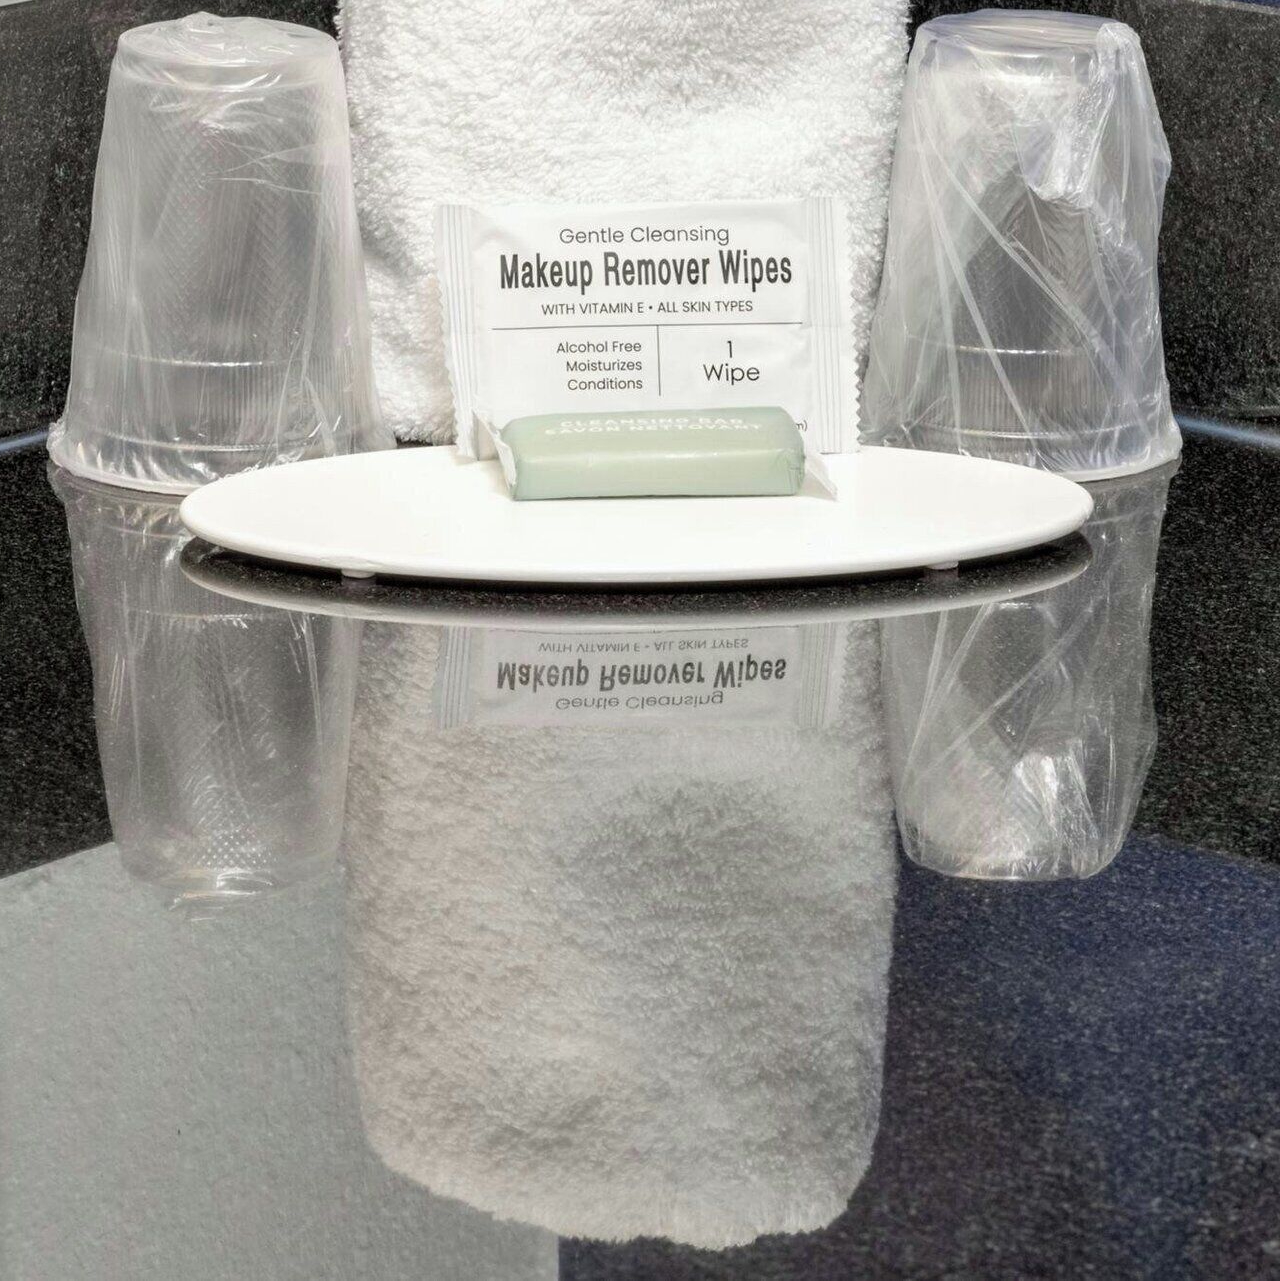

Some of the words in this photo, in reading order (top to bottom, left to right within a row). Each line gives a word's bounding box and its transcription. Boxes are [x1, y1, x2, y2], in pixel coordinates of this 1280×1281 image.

[559, 226, 625, 244] Gentle
[630, 225, 730, 247] Cleansing
[500, 252, 593, 296] Makeup
[603, 251, 710, 287] Remover
[718, 249, 792, 293] Wipes
[541, 303, 576, 316] WITH
[578, 302, 634, 315] VITAMIN
[637, 301, 644, 314] E
[657, 301, 679, 313] ALL
[682, 301, 711, 313] SKIN
[714, 300, 754, 312] TYPES
[556, 340, 608, 354] Alcohol
[612, 340, 642, 353] Free
[726, 340, 733, 359] 1
[566, 359, 643, 372] Moisturizes
[702, 362, 760, 386] Wipe
[567, 377, 643, 391] Conditions
